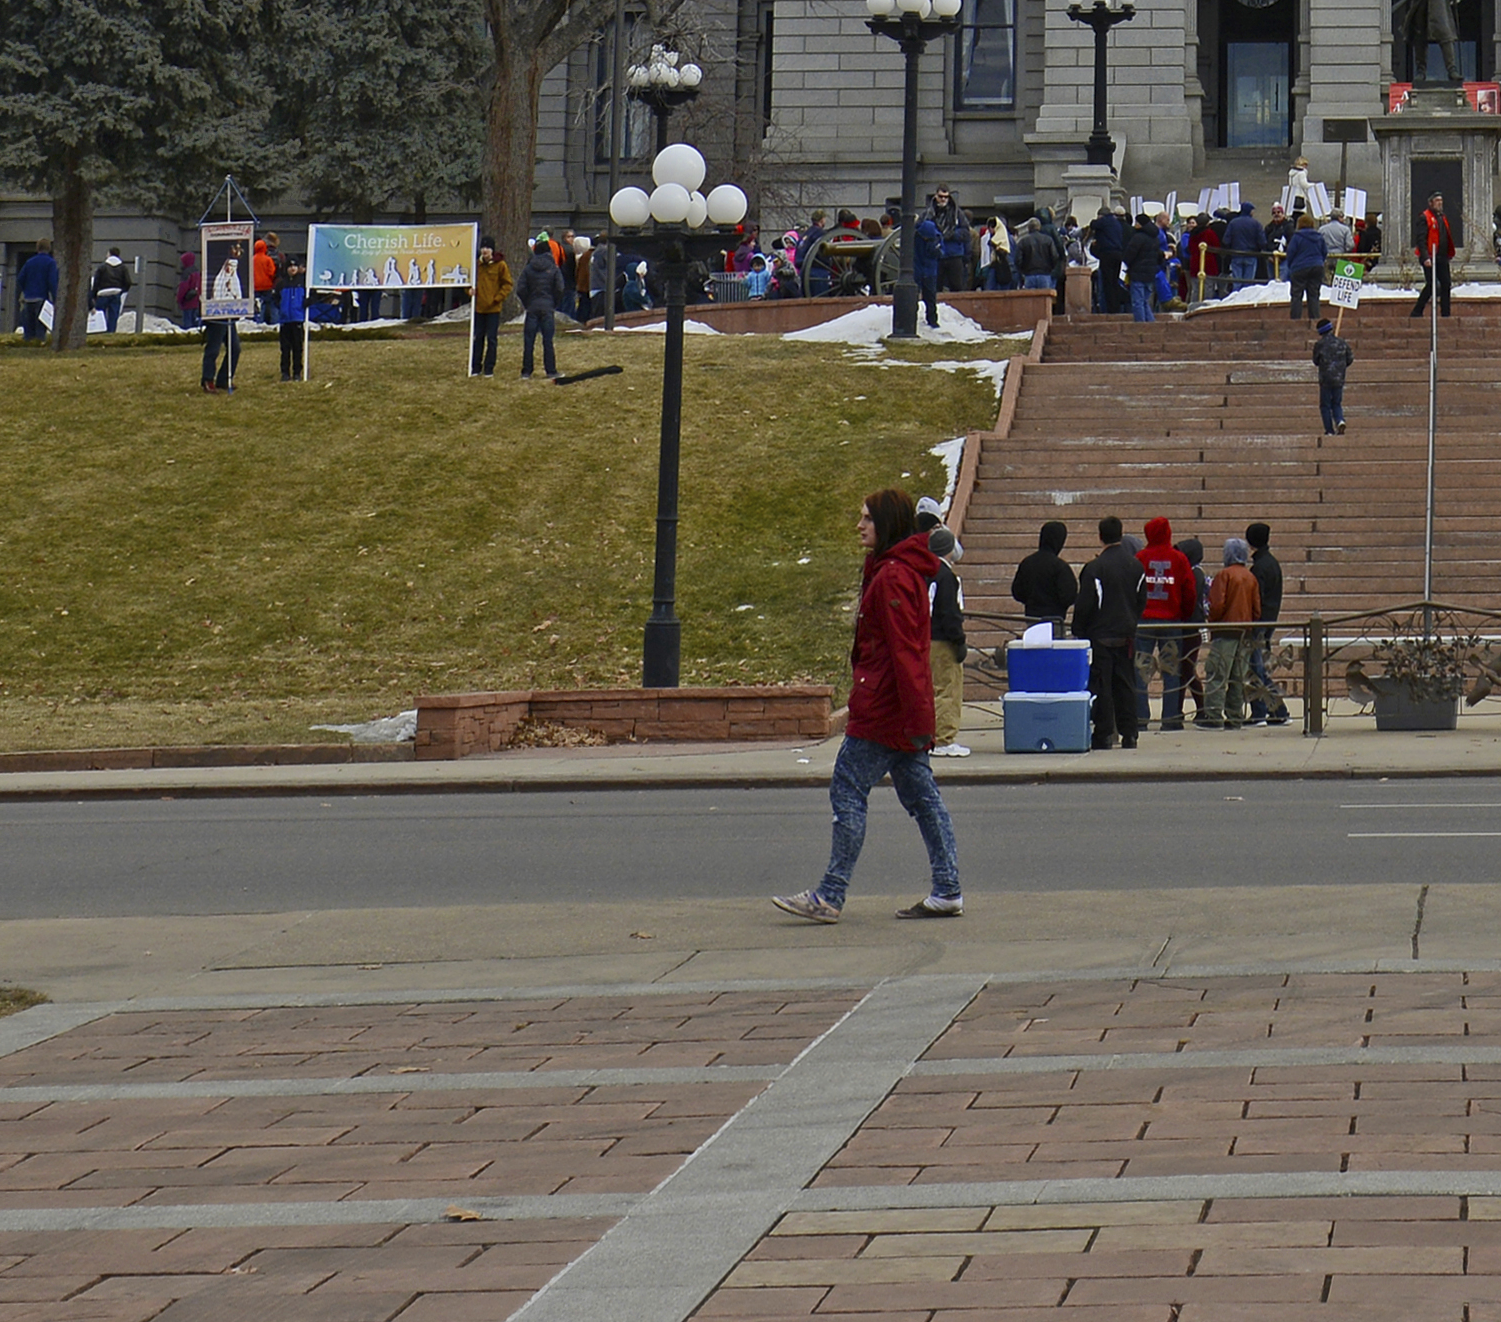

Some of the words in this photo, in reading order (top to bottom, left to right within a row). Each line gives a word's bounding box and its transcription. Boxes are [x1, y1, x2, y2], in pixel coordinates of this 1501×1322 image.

[344, 233, 408, 249] Cherish
[413, 233, 446, 247] Life.
[1333, 277, 1360, 292] DEFEND
[1337, 290, 1352, 303] LIFE
